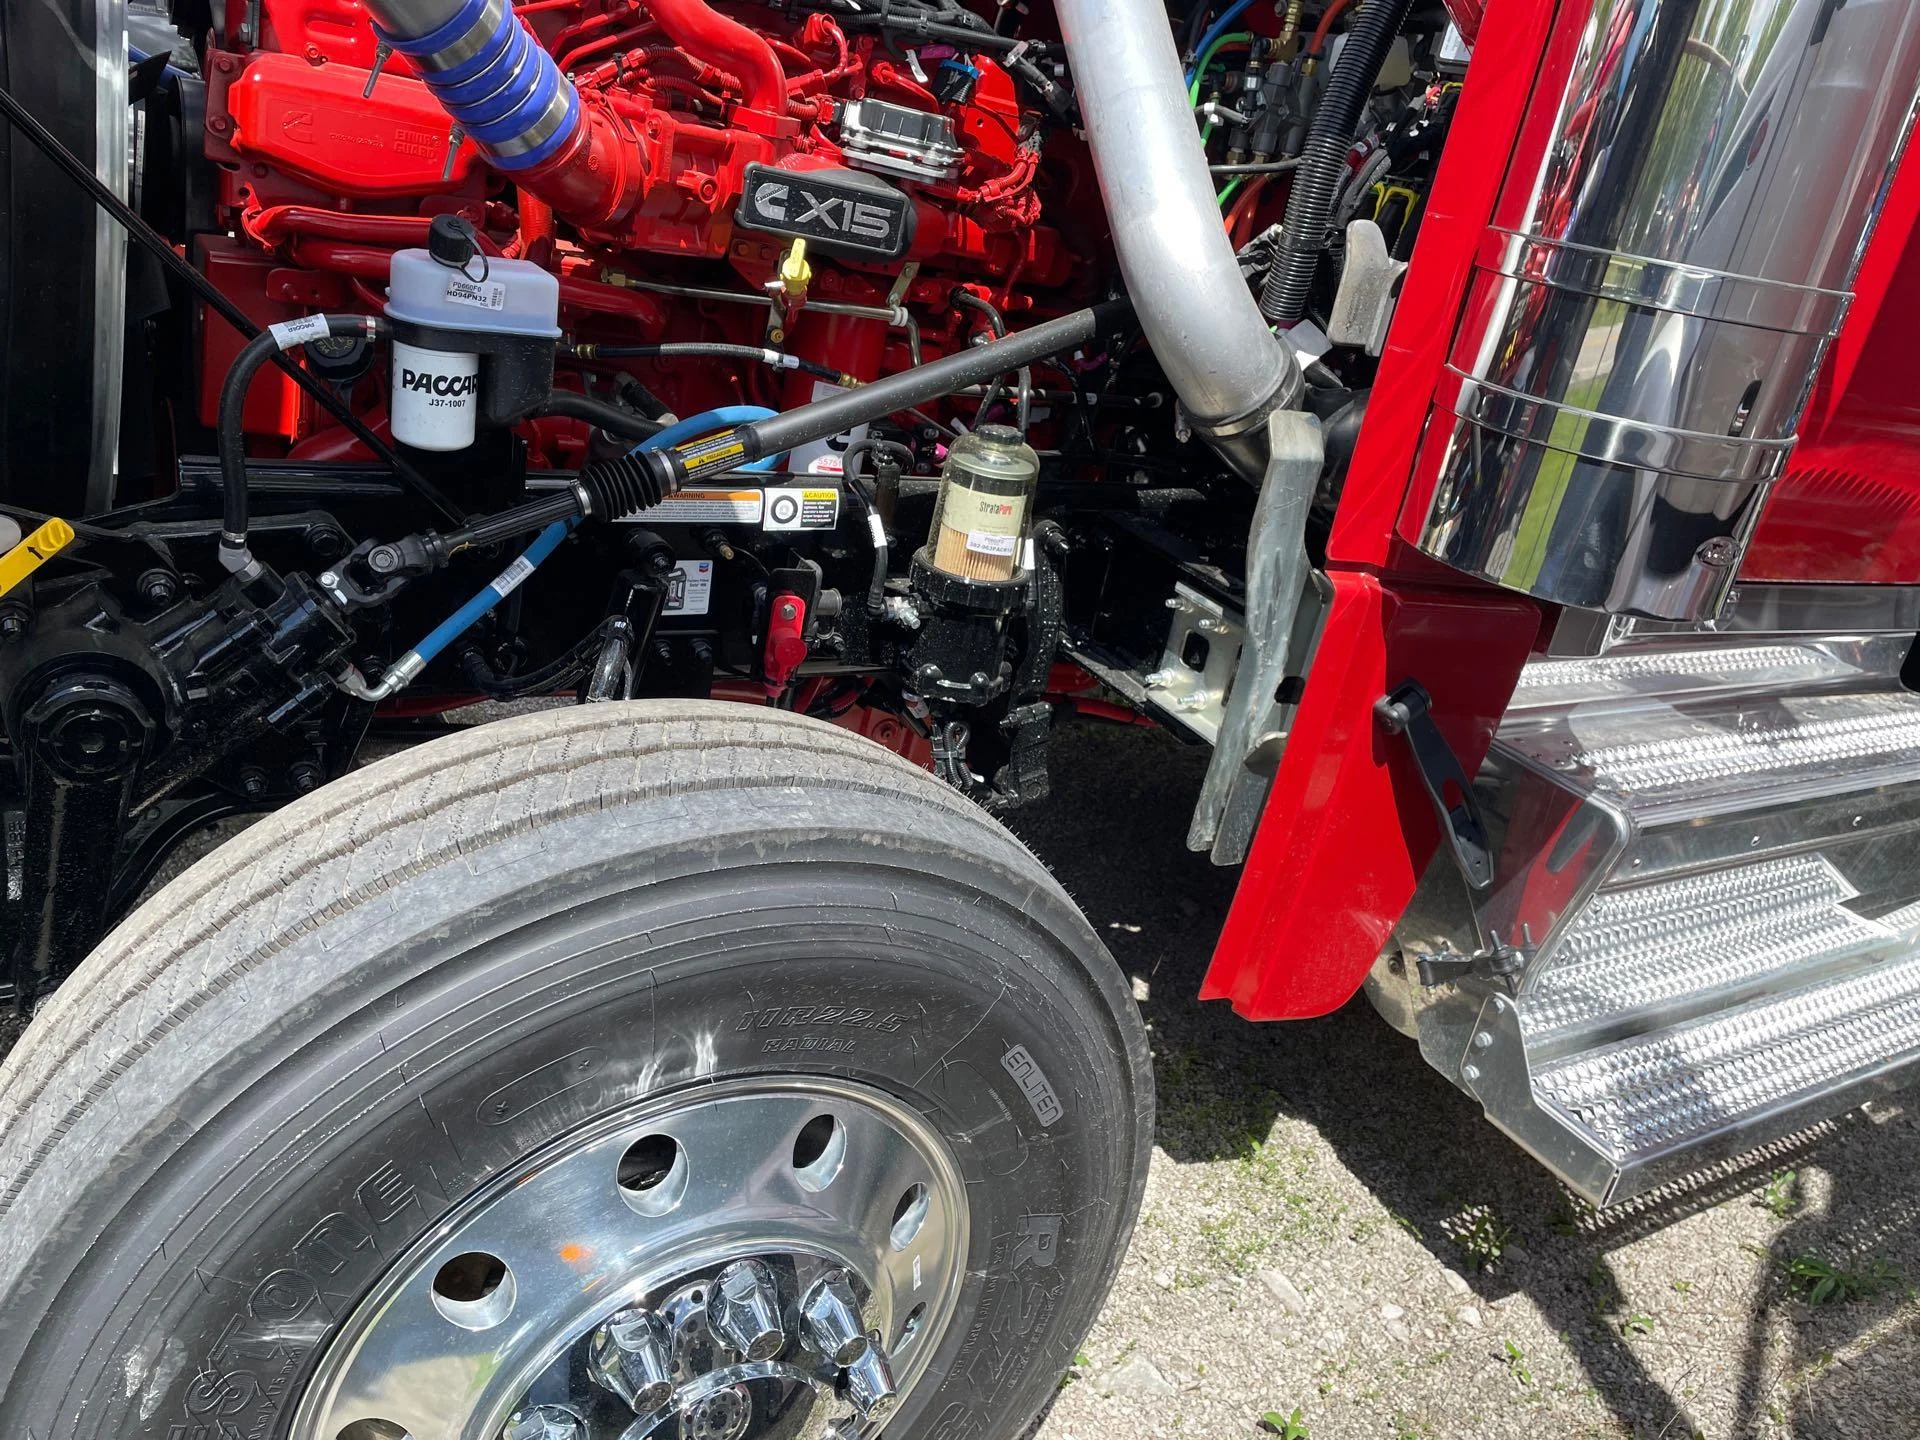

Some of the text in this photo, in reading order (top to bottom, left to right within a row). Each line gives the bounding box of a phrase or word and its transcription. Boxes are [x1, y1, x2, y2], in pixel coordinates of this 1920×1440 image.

[795, 190, 891, 238] X15
[446, 290, 487, 303] HD94PN32
[428, 399, 466, 408] J37-1007
[674, 491, 705, 499] WARNING
[761, 1037, 857, 1054] RADIAL
[1007, 1051, 1059, 1124] ENLITEN
